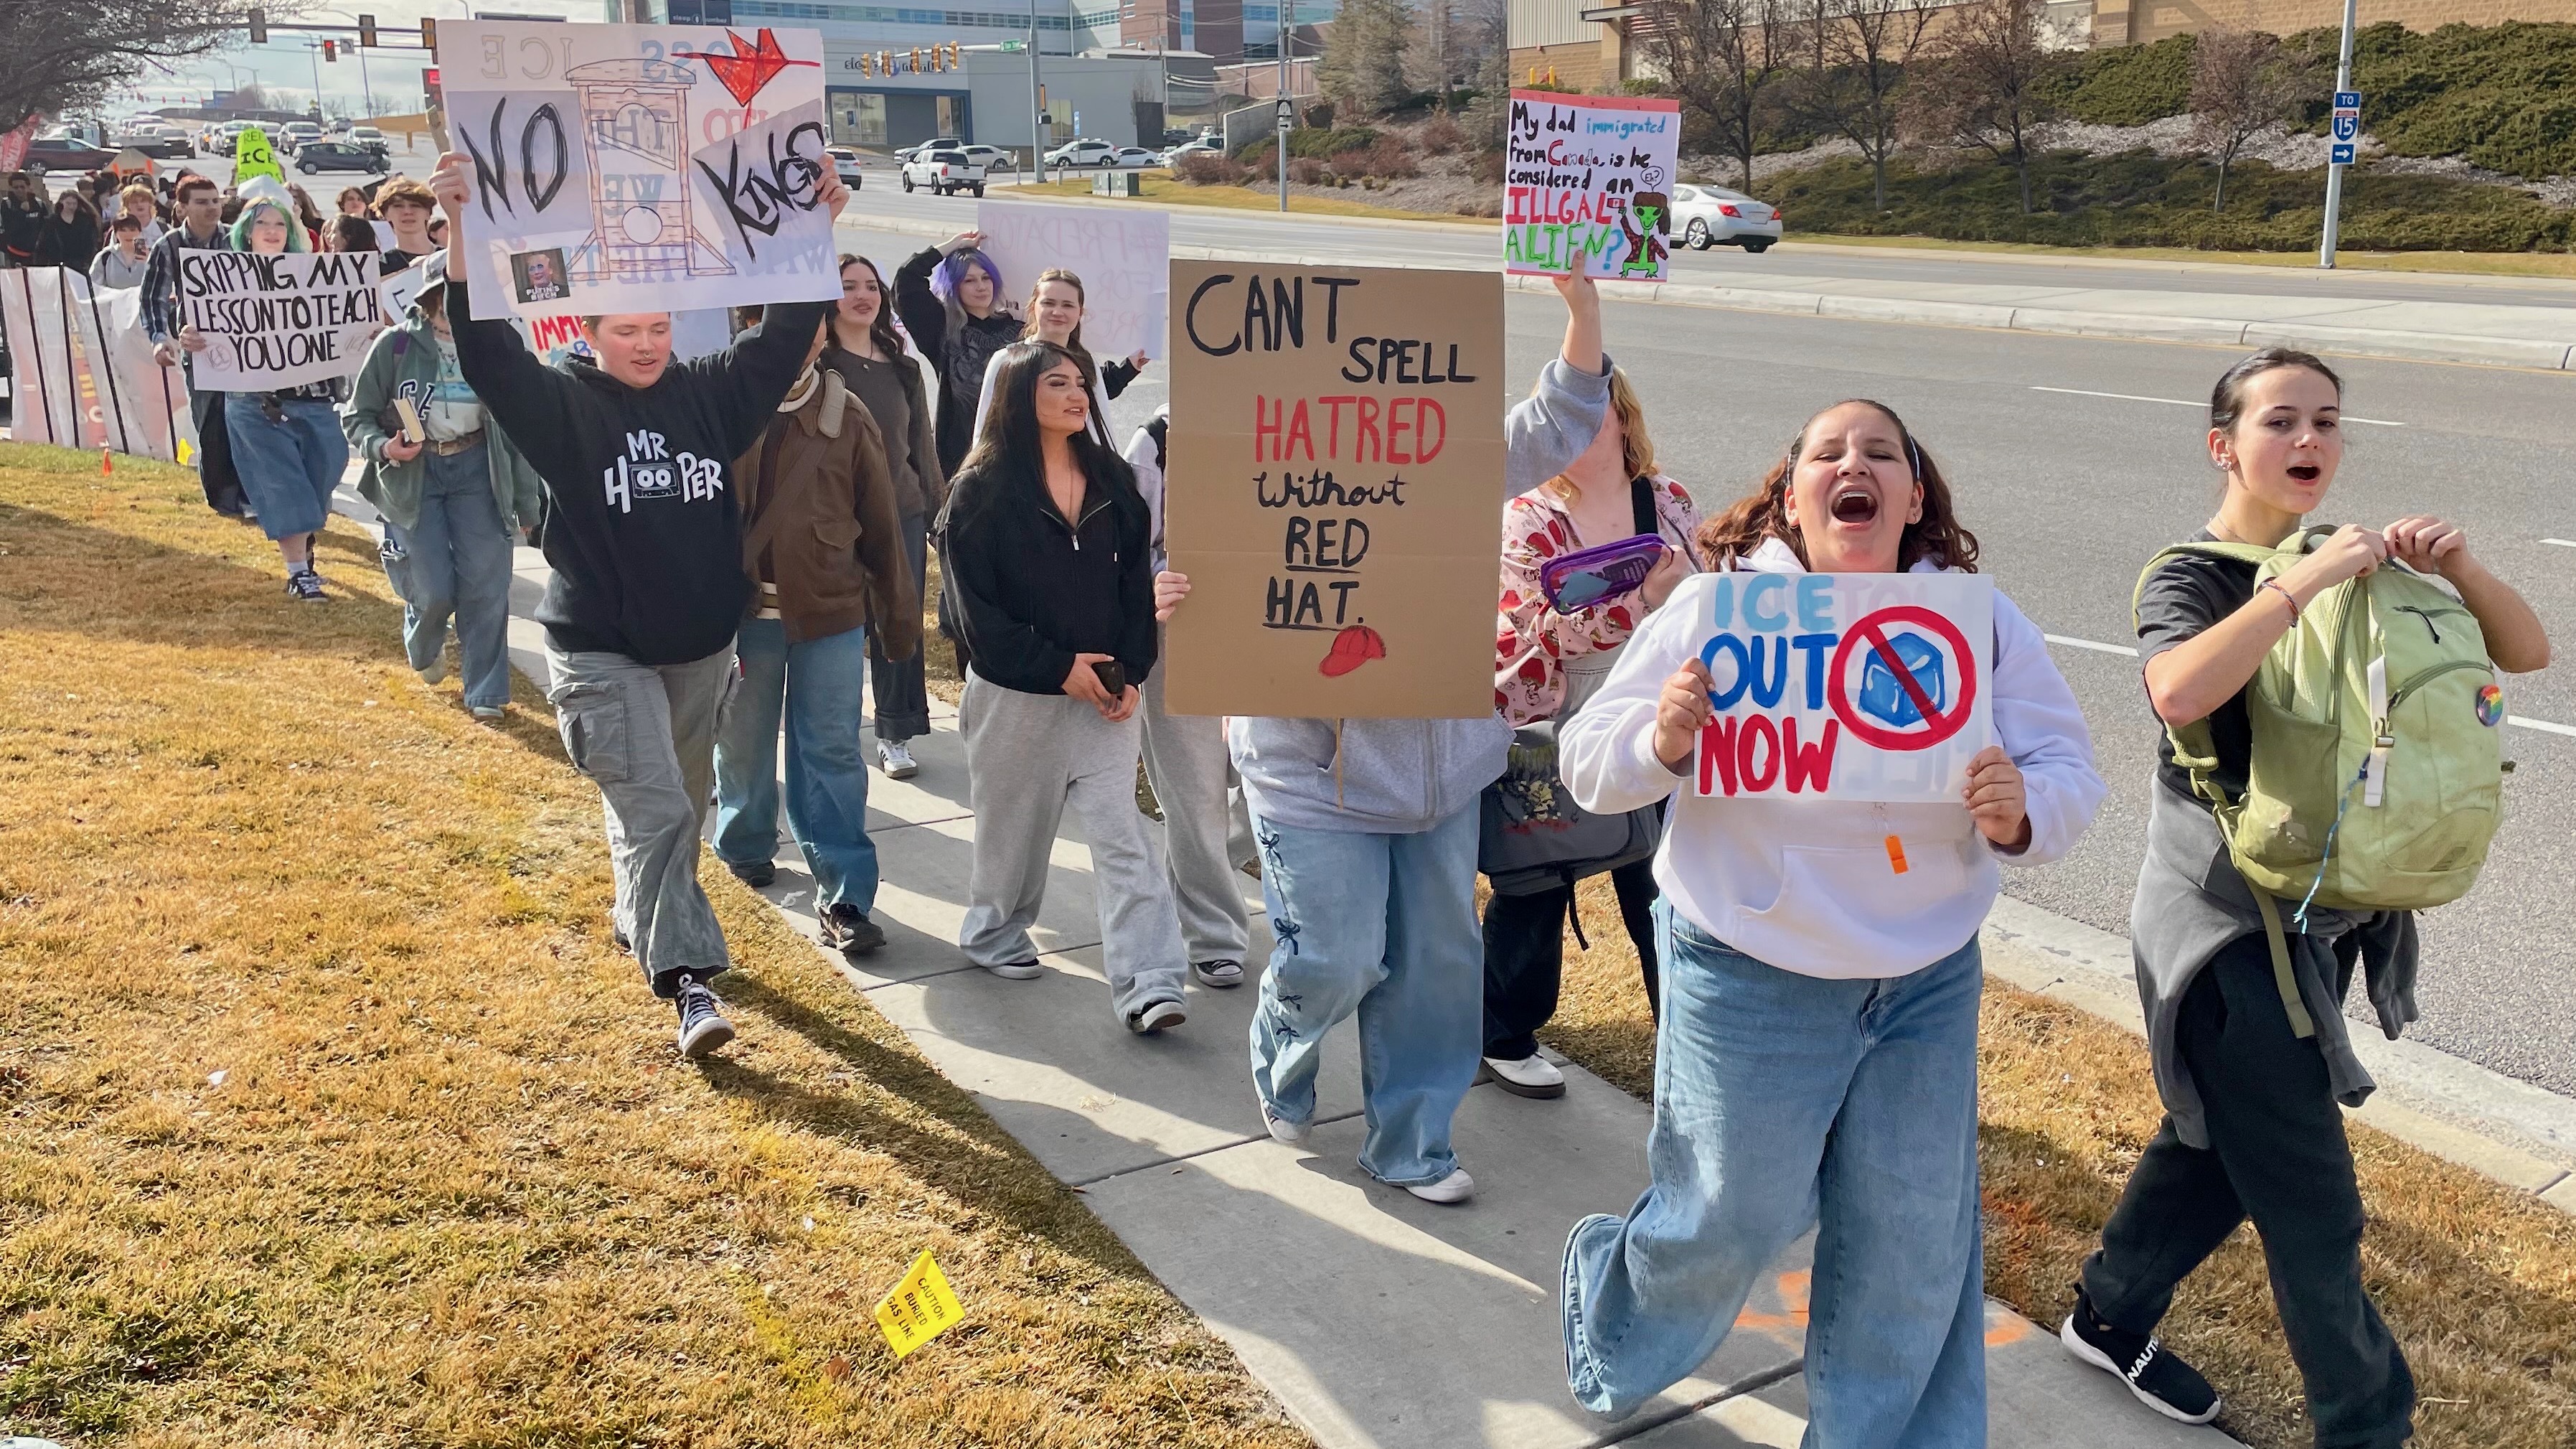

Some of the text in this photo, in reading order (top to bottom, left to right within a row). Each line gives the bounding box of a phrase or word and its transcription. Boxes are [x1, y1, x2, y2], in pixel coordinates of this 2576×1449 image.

[1510, 100, 1667, 141] My dad immigrated
[2341, 95, 2354, 105] TO
[2338, 118, 2354, 136] 15
[458, 95, 569, 225] NO
[1509, 134, 1547, 164] from
[1609, 153, 1625, 168] is
[1629, 146, 1651, 169] he
[1508, 166, 1634, 194] considered an
[1505, 186, 1613, 225] ILLGAL
[182, 252, 370, 297] SKIPPING MY
[1185, 274, 1360, 357] CANT
[1340, 337, 1480, 385] SPELL
[626, 428, 670, 462] MR
[1254, 394, 1447, 465] HATRED
[603, 451, 724, 515] HOOPER
[1284, 515, 1371, 568] RED
[1264, 575, 1364, 626] HAT.
[1714, 573, 1836, 632] ICE
[1699, 632, 1840, 711] OUT
[1698, 713, 1840, 797] NOW
[886, 1295, 916, 1341] GAS LINE
[903, 1292, 929, 1326] BURIED
[918, 1277, 946, 1321] CAUTION
